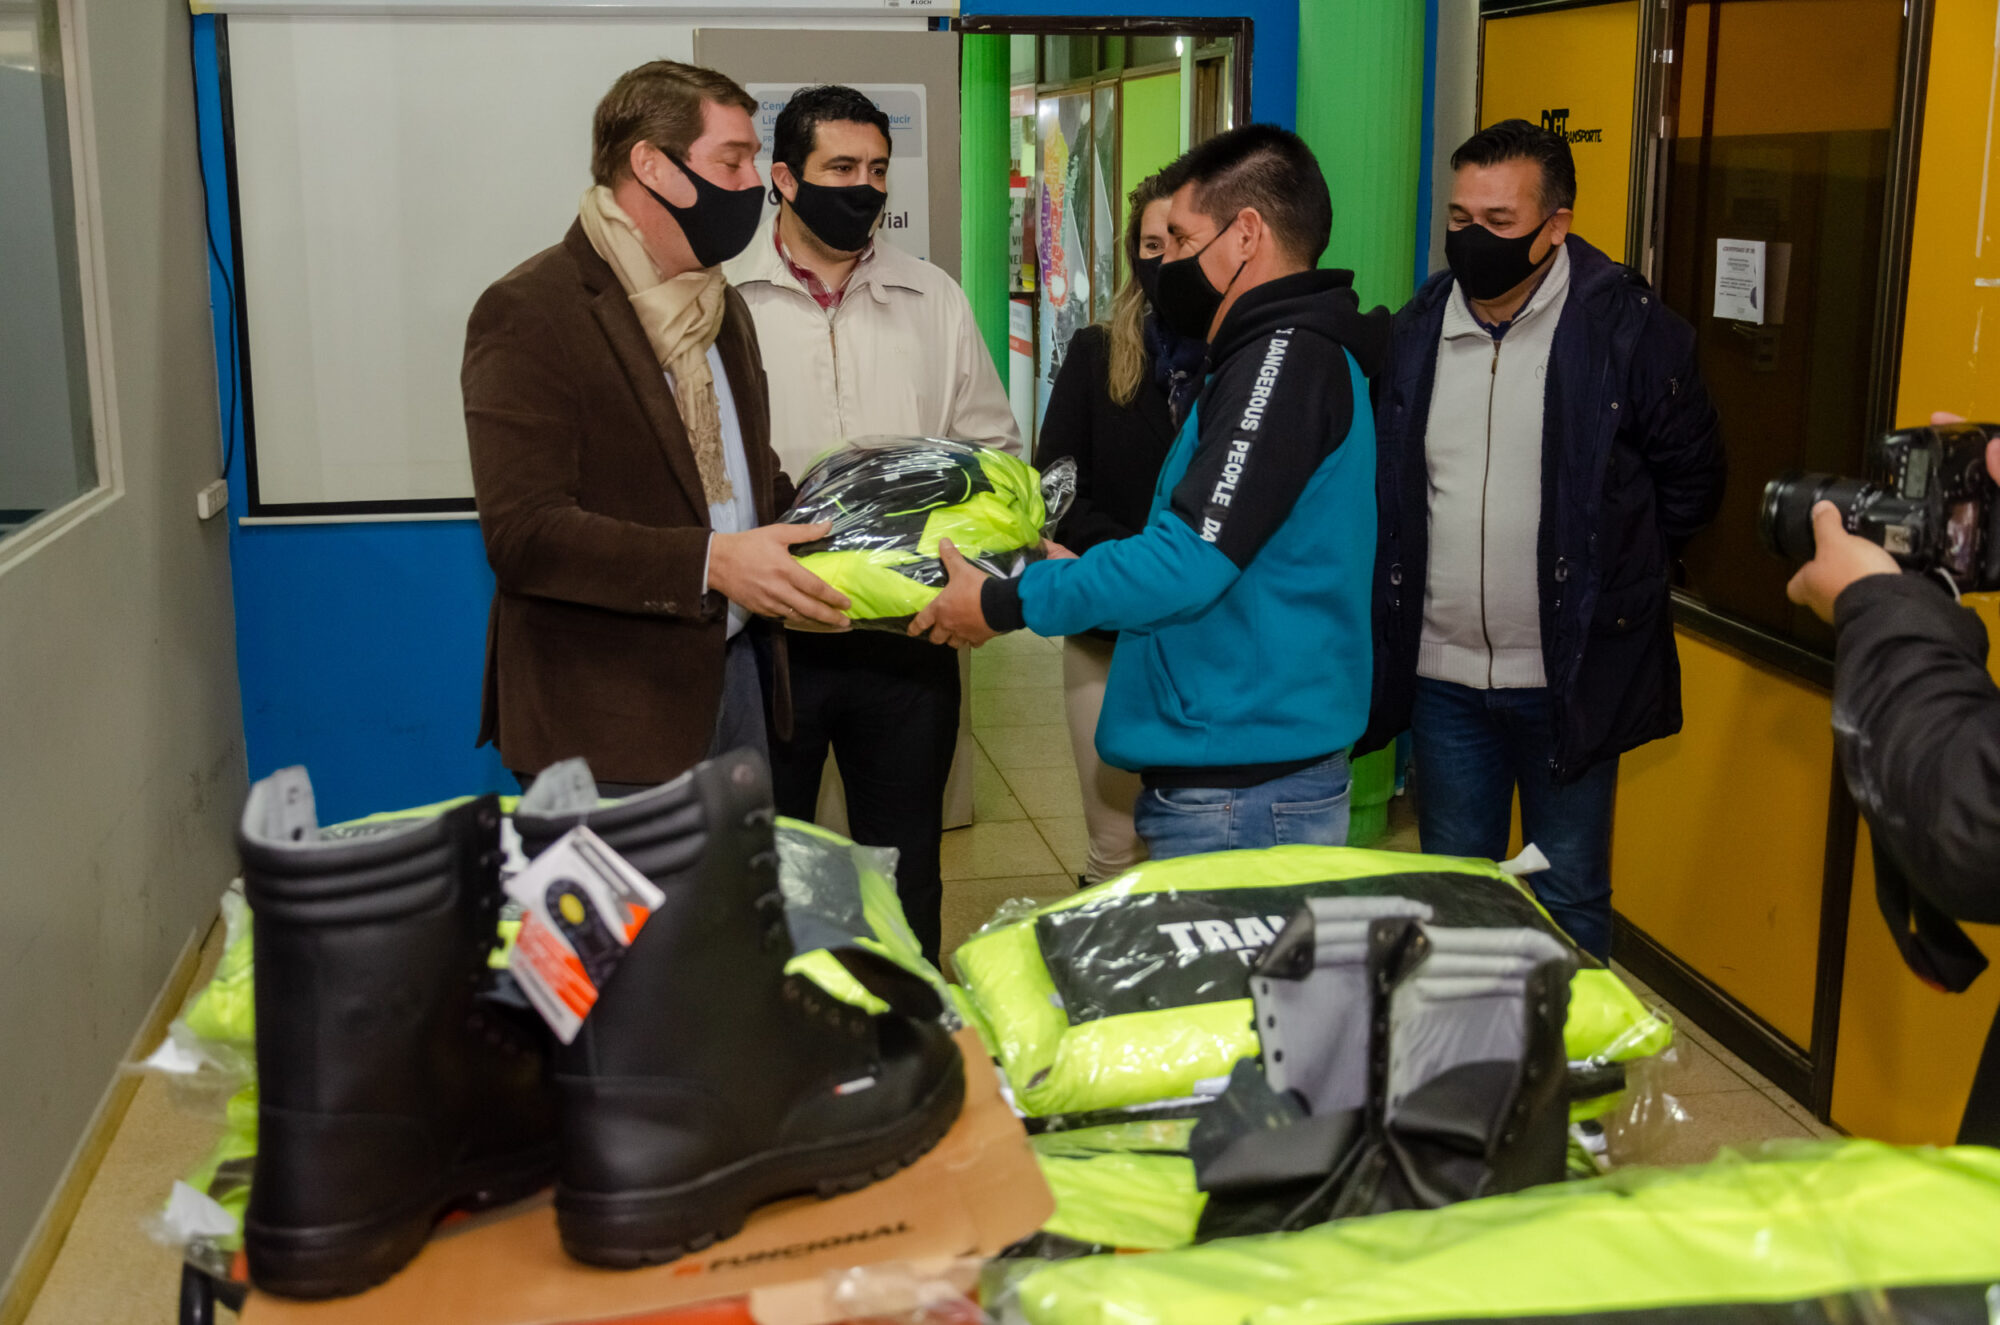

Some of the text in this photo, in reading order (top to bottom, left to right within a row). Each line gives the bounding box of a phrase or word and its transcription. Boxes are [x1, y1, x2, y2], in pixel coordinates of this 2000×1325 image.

[761, 101, 785, 111] Cent
[889, 114, 911, 125] ducir
[1240, 338, 1289, 432] DANGEROUS
[1211, 440, 1250, 507] PEOPLE
